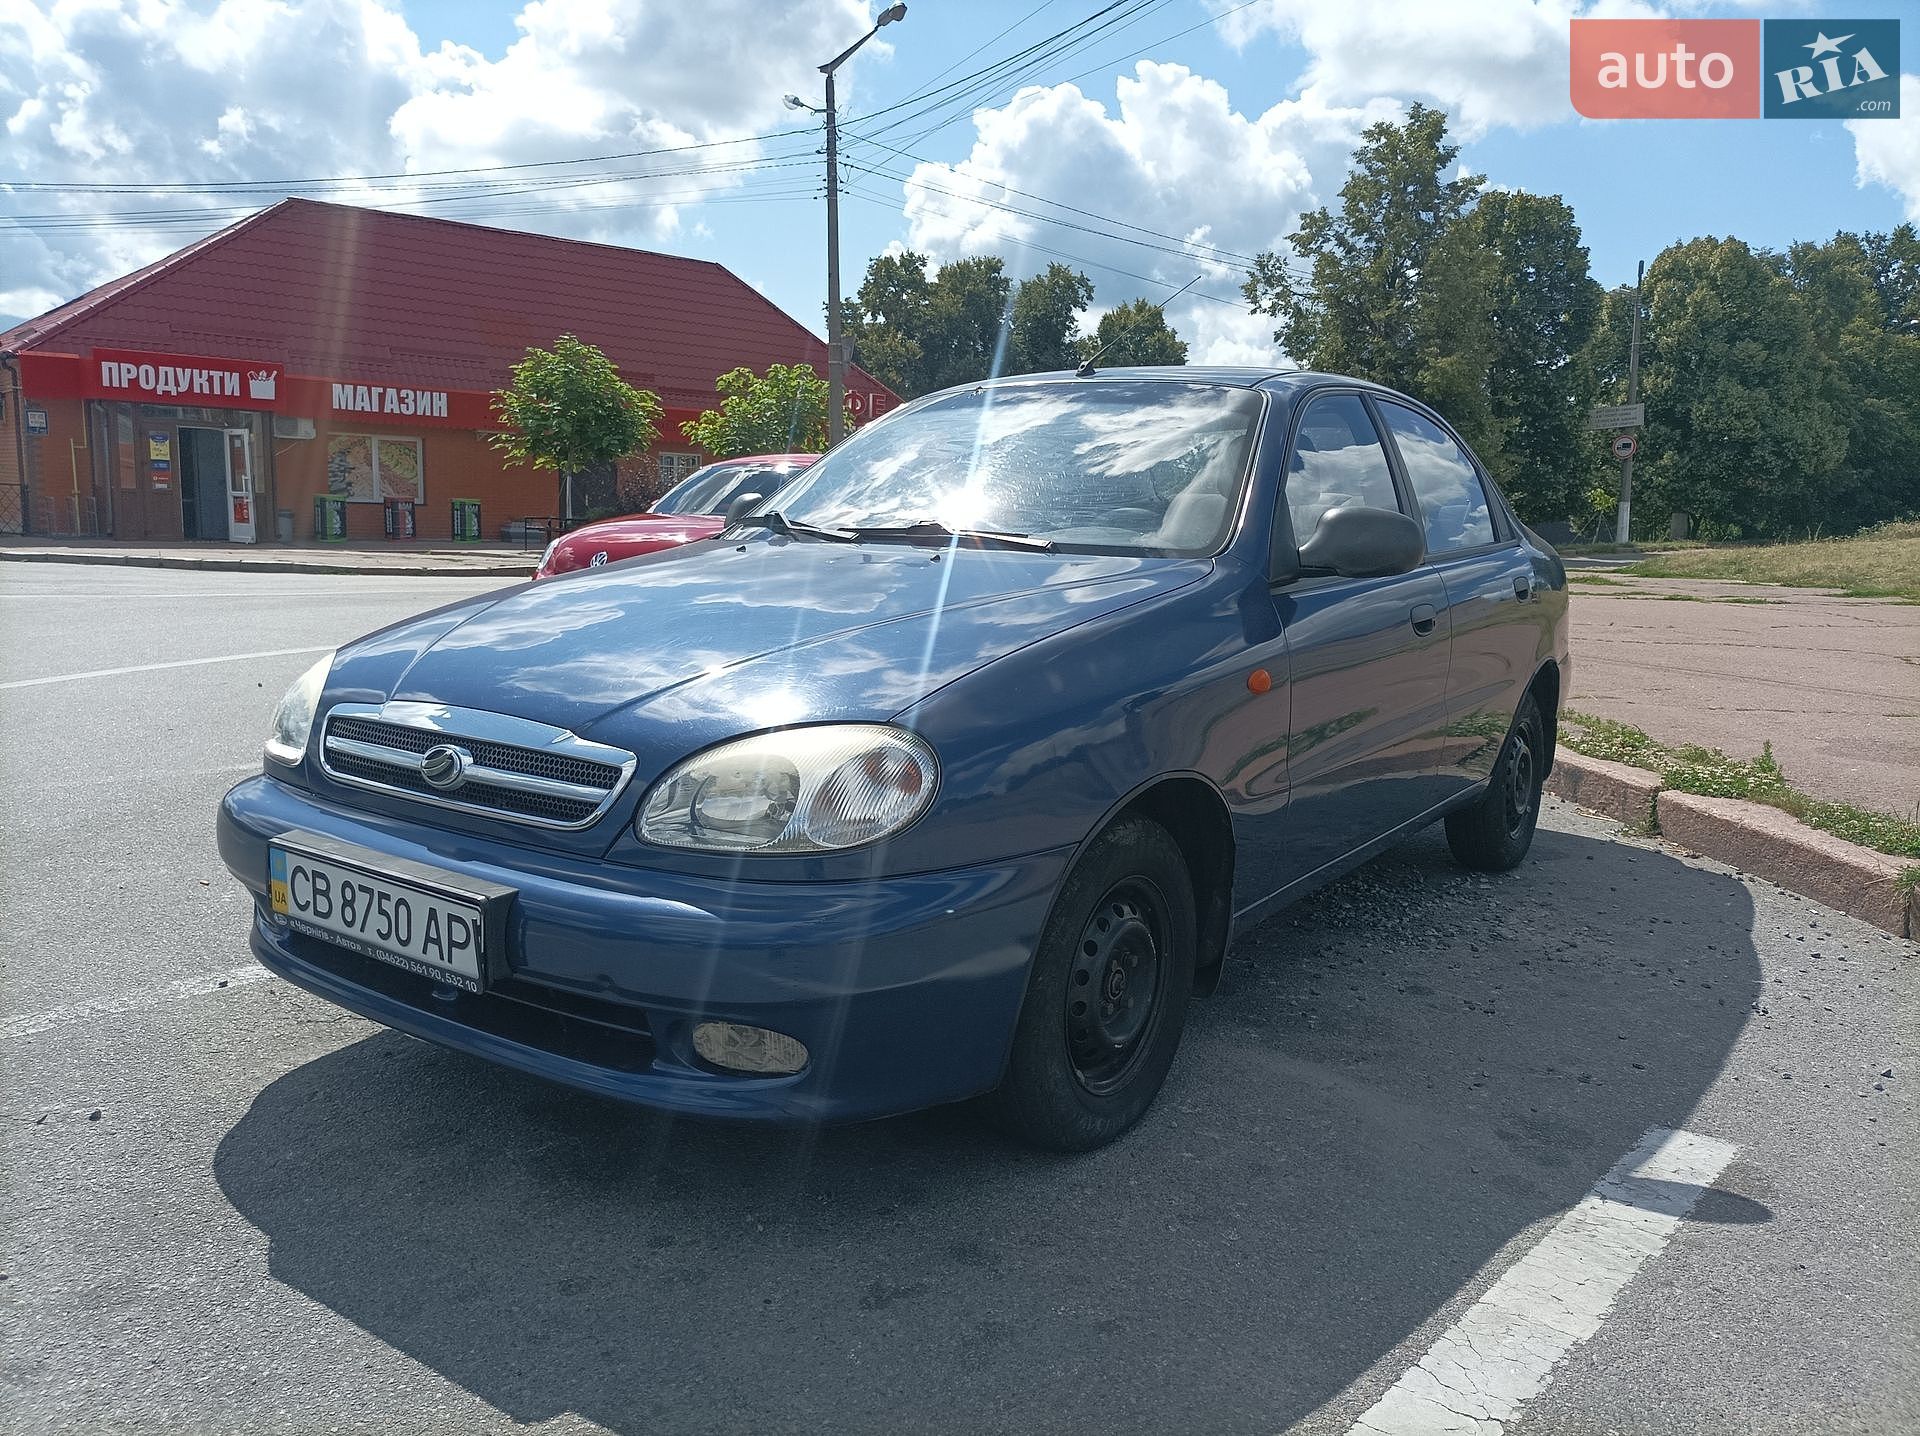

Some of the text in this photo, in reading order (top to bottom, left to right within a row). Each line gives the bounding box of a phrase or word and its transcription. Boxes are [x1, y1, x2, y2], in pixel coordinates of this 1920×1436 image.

[101, 361, 241, 396] ПРОДУКТИ
[332, 383, 448, 418] МАГАЗИН
[843, 389, 887, 419] ФЕ
[274, 890, 288, 905] UA
[340, 880, 412, 947] 8750
[445, 973, 464, 987] 532
[465, 980, 477, 992] 10
